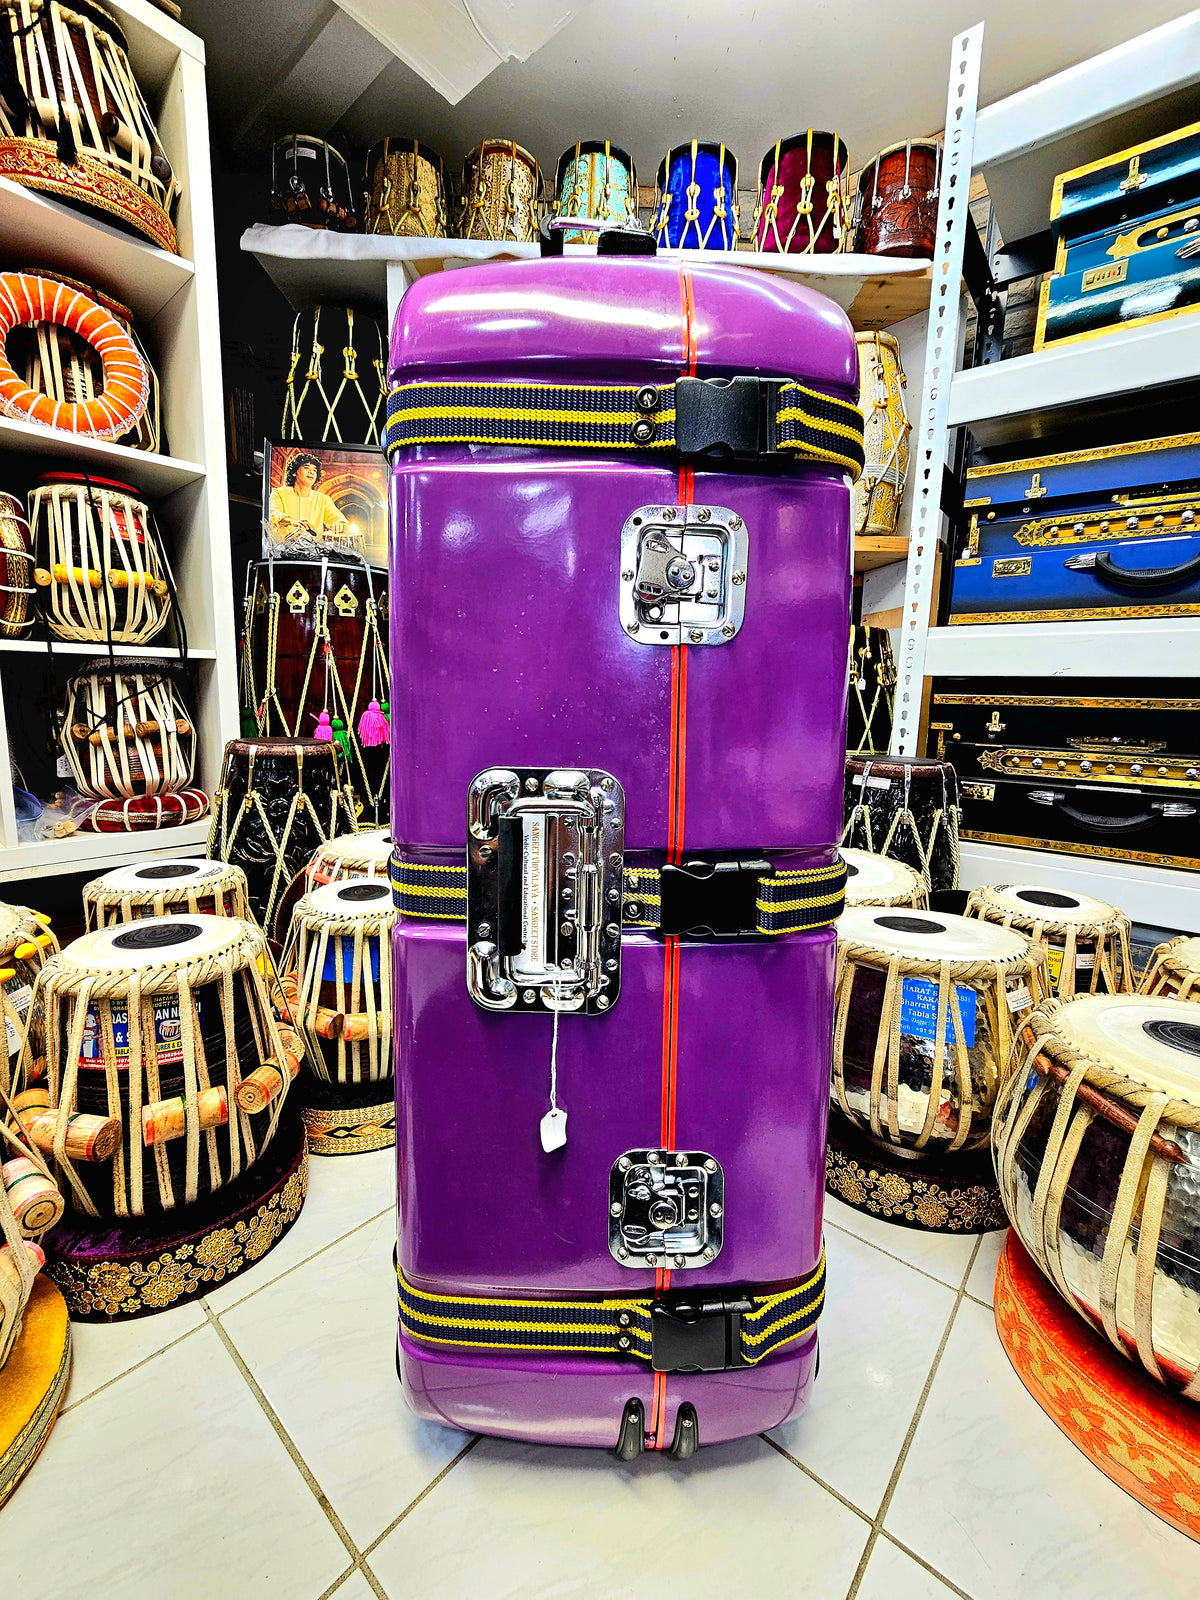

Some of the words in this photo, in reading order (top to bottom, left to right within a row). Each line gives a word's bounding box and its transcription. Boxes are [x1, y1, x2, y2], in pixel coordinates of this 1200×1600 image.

[531, 821, 540, 857] SANGEET
[531, 857, 540, 898] VIDYALAYA
[530, 906, 540, 940] SANGEET
[530, 940, 539, 962] STORE
[907, 1008, 930, 1019] Tabla
